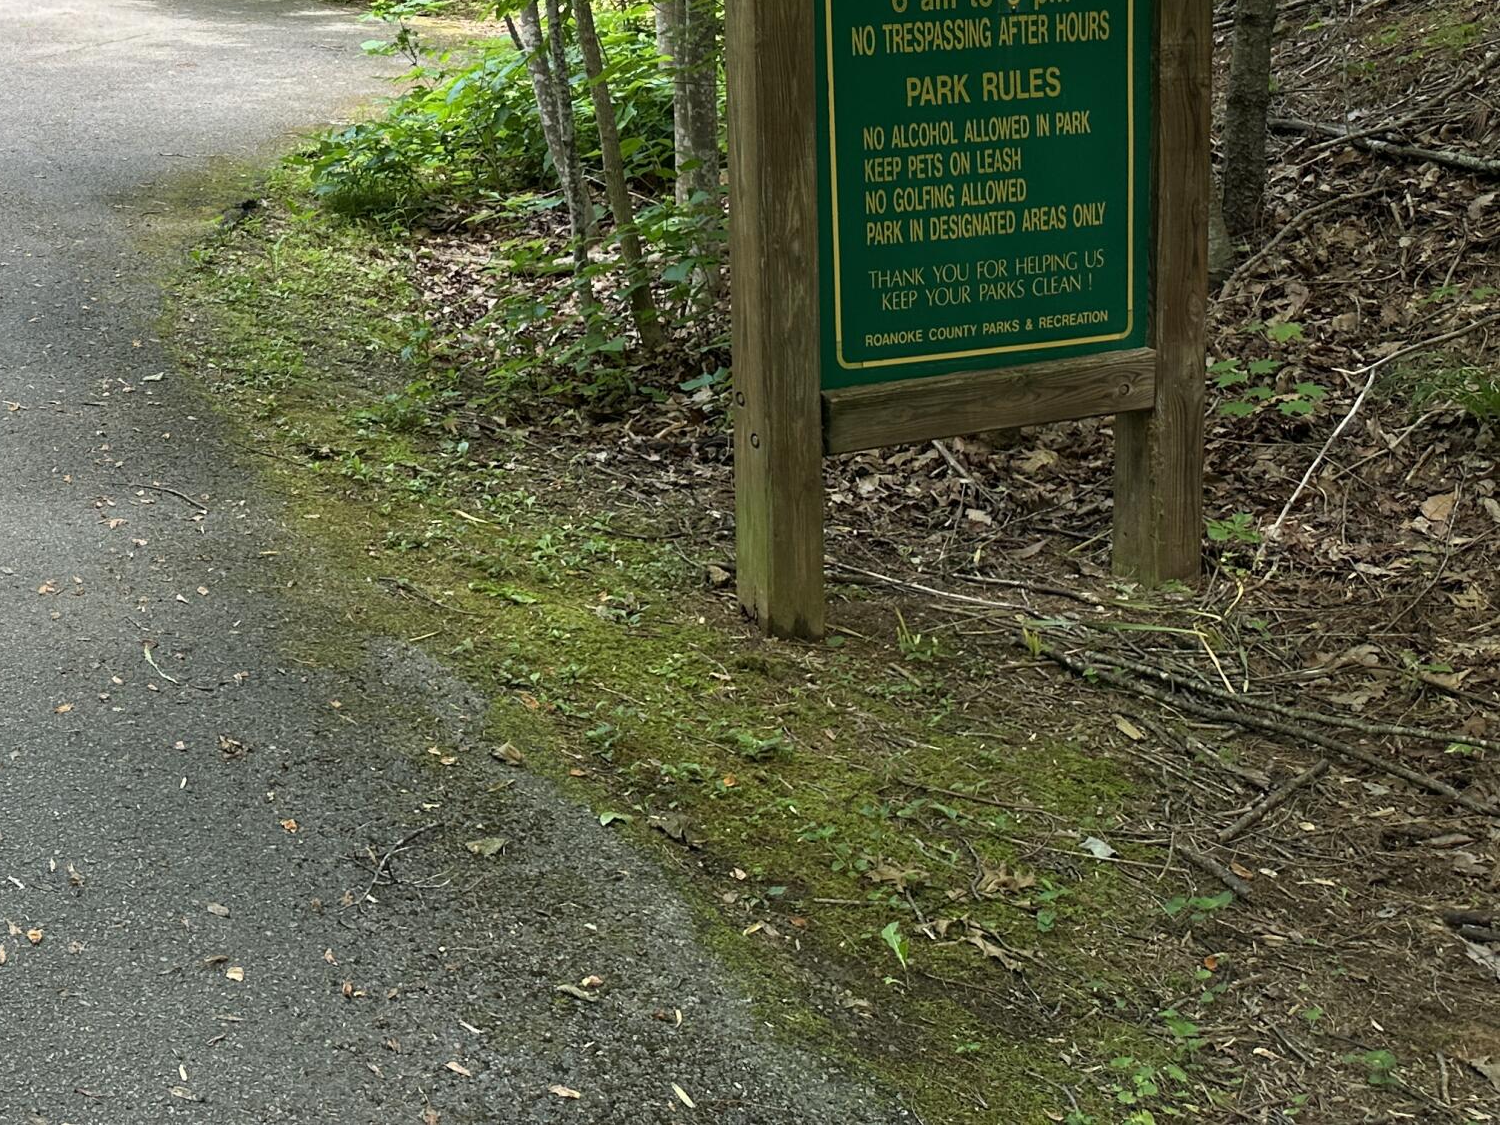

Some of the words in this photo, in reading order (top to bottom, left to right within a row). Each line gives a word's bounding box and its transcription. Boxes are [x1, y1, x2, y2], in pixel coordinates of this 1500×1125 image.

[851, 25, 876, 56] NO
[882, 17, 992, 54] TRESPASSING
[998, 14, 1049, 46] AFTER
[1056, 10, 1110, 43] HOURS
[906, 74, 971, 107] PARK
[982, 66, 1061, 102] RULES
[863, 126, 885, 150] NO
[891, 121, 959, 149] ALCOHOL
[964, 114, 1030, 143] ALLOWED
[1036, 113, 1050, 137] IN
[1055, 110, 1091, 135] PARK
[864, 156, 902, 183] KEEP
[908, 153, 943, 179] PETS
[949, 151, 971, 177] ON
[976, 147, 1021, 174] LEASH
[865, 189, 887, 215] NO
[893, 183, 955, 213] GOLFING
[960, 178, 1027, 207] ALLOWED
[866, 219, 904, 246] PARK
[909, 218, 924, 242] IN
[929, 210, 1016, 241] DESIGNATED
[1021, 204, 1067, 232] AREAS
[1072, 201, 1106, 228] ONLY
[868, 267, 925, 289] THANK
[932, 264, 969, 283] YOU
[977, 259, 1008, 280] FOR
[1015, 251, 1078, 276] HELPING
[1085, 248, 1104, 268] US
[882, 290, 918, 311] KEEP
[925, 285, 971, 306] YOUR
[979, 279, 1025, 301] PARKS
[1032, 274, 1081, 296] CLEAN
[1087, 273, 1093, 291] !
[865, 329, 923, 347] ROANOKE
[928, 324, 977, 341] COUNTY
[982, 319, 1020, 335] PARKS
[1025, 318, 1033, 331] &
[1038, 310, 1109, 329] RECREATION
